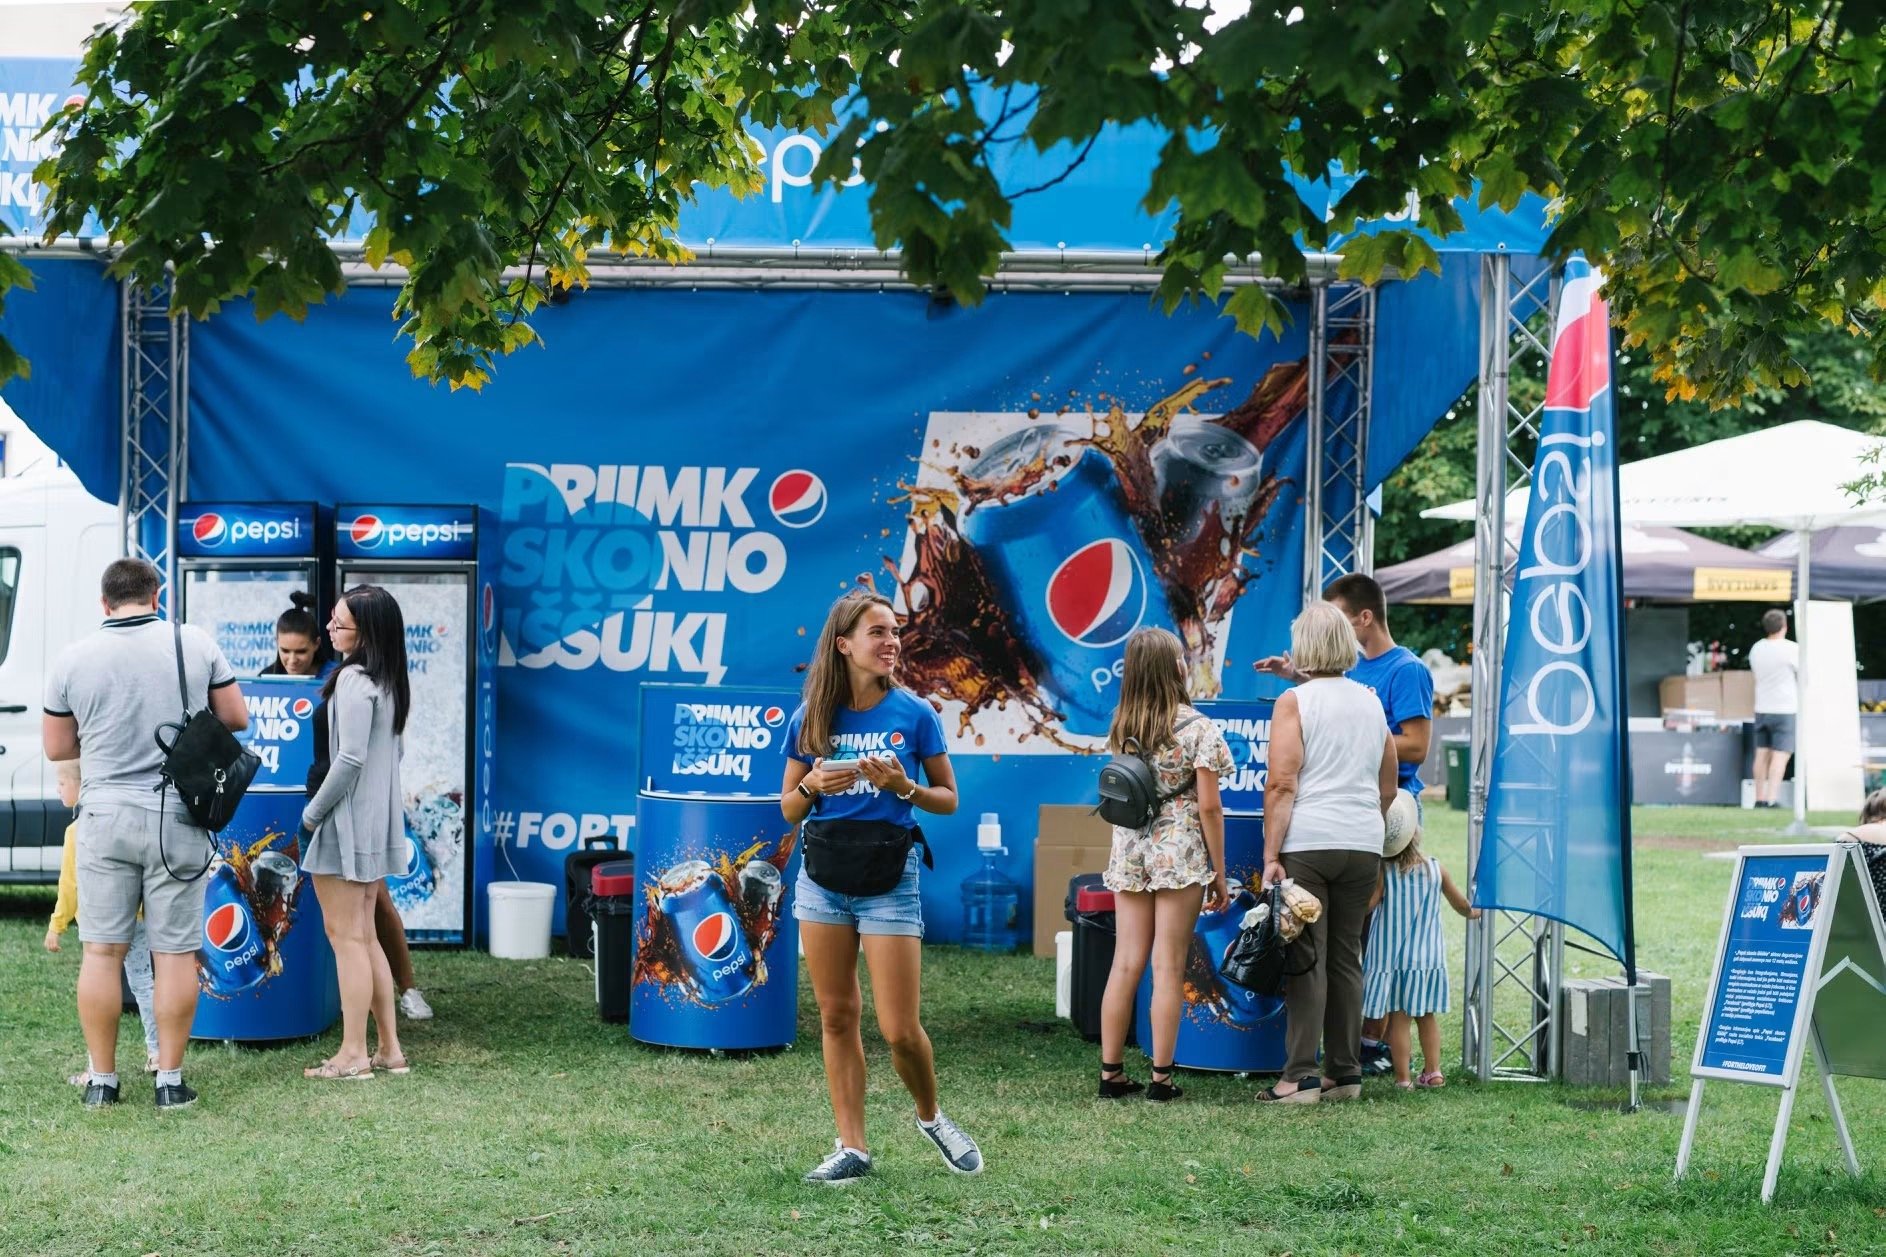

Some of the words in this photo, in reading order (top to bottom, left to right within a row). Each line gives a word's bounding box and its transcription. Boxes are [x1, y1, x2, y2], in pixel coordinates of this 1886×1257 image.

[502, 462, 761, 528] PRIIMK
[231, 518, 300, 544] pepsi
[388, 520, 459, 546] pepsi
[500, 526, 788, 594] SKONIO
[674, 703, 763, 728] PRIIMK
[672, 725, 772, 750] SKONIO
[491, 811, 636, 851] #FORT
[1744, 889, 1780, 903] SKONIO
[224, 941, 259, 973] pepsi
[712, 950, 747, 982] pepsi
